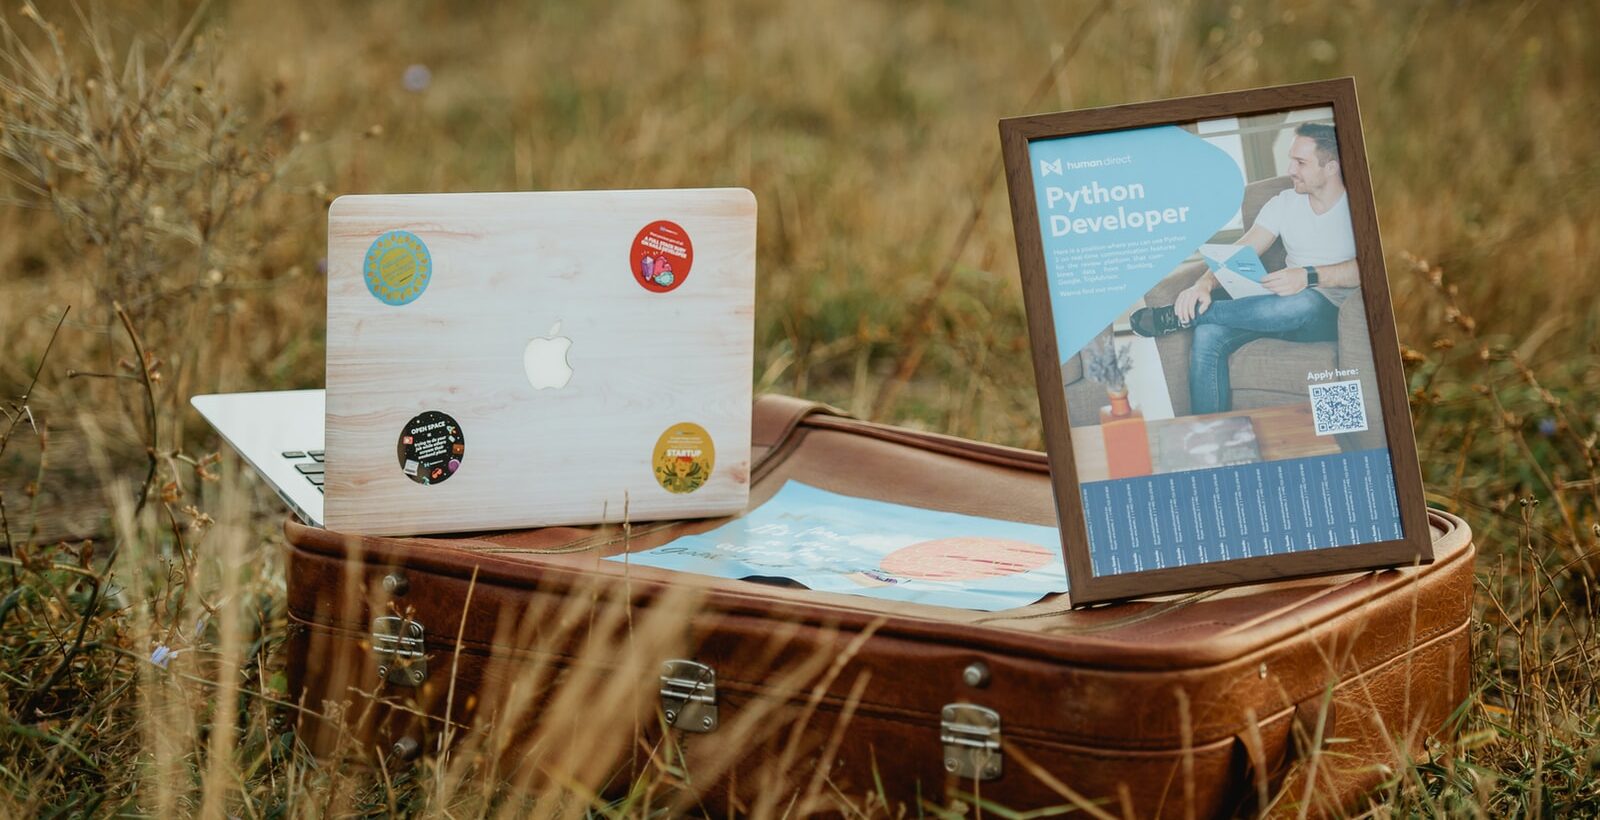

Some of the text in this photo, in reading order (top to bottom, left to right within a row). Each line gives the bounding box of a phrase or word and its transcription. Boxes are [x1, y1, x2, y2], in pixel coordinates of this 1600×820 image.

[1046, 181, 1145, 213] Python
[1050, 206, 1189, 237] Developer
[1307, 368, 1360, 381] Apply here:
[411, 421, 445, 434] OPEN SPACE
[667, 449, 702, 457] STARTUP
